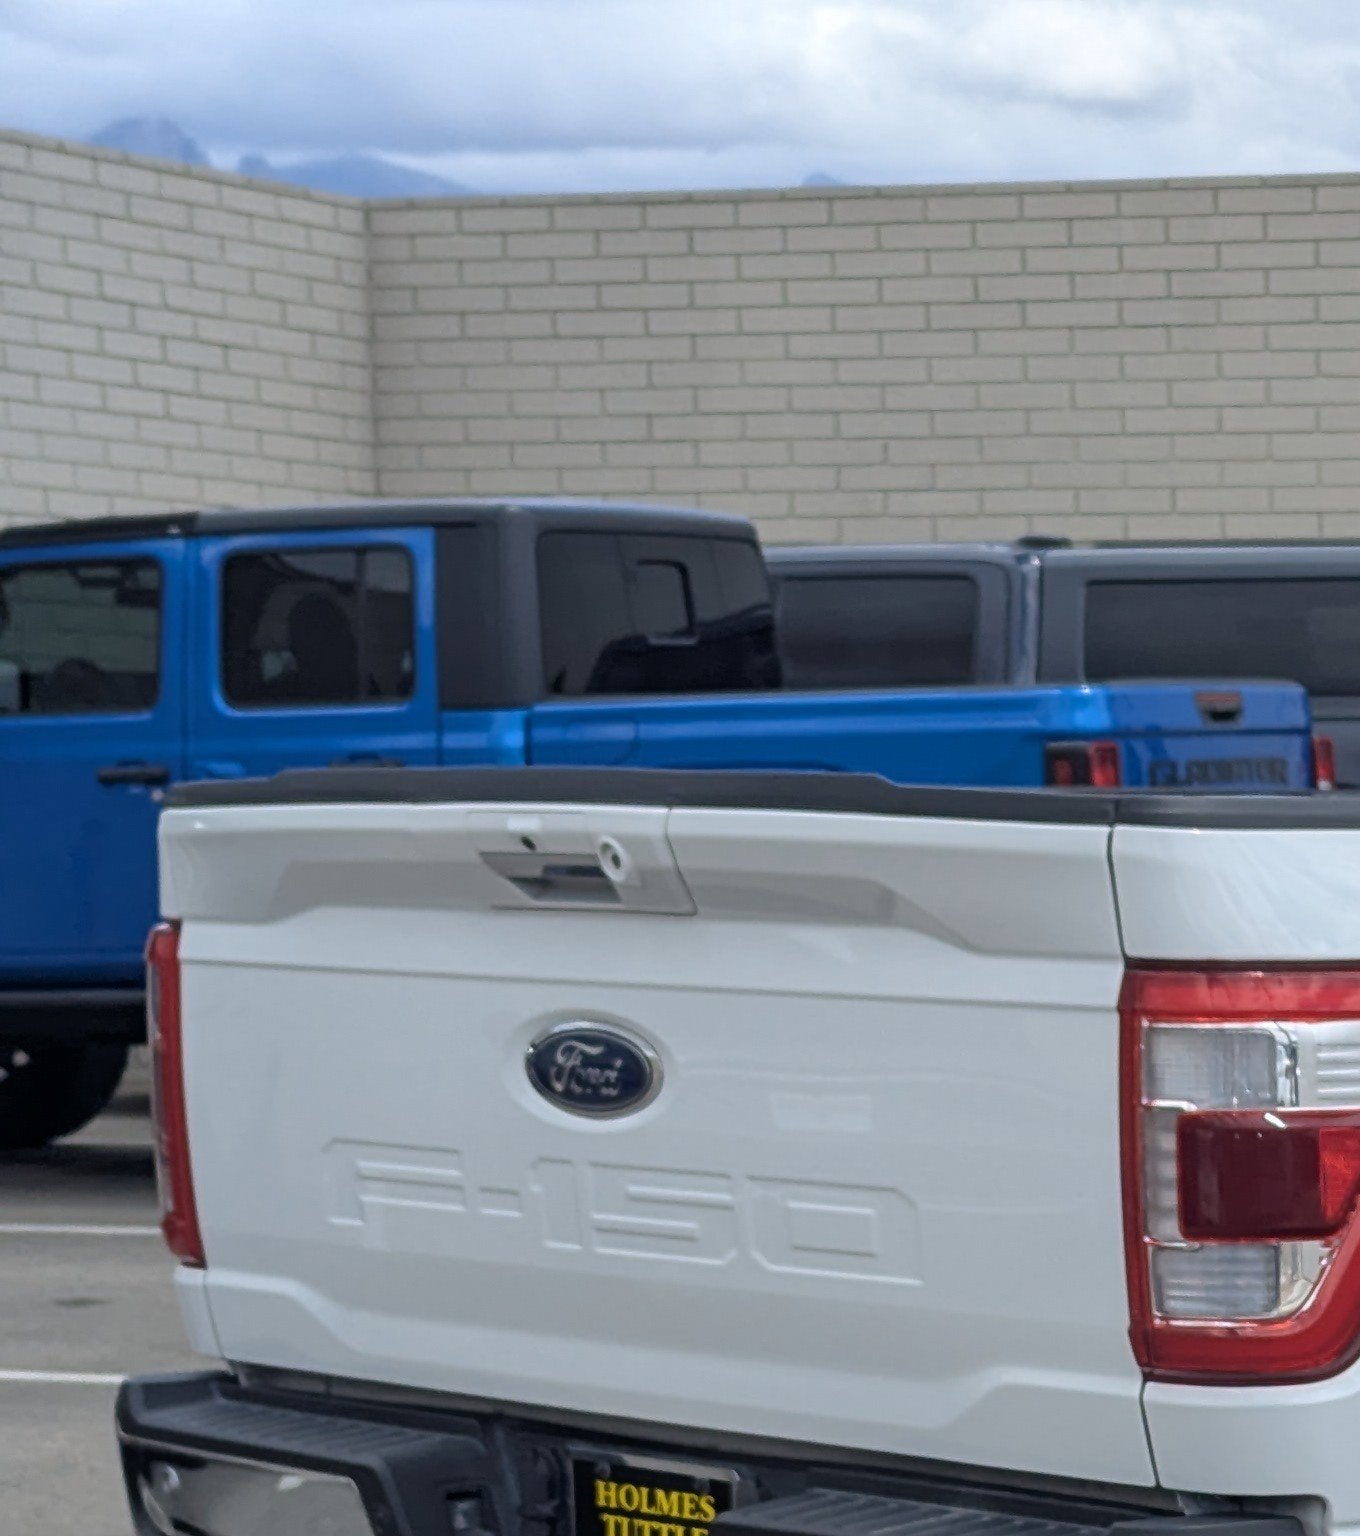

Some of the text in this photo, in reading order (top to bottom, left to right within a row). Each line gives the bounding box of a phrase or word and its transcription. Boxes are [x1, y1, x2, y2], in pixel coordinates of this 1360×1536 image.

[551, 1040, 624, 1096] Ford
[323, 1138, 923, 1287] F-150
[594, 1478, 716, 1523] HOLMES
